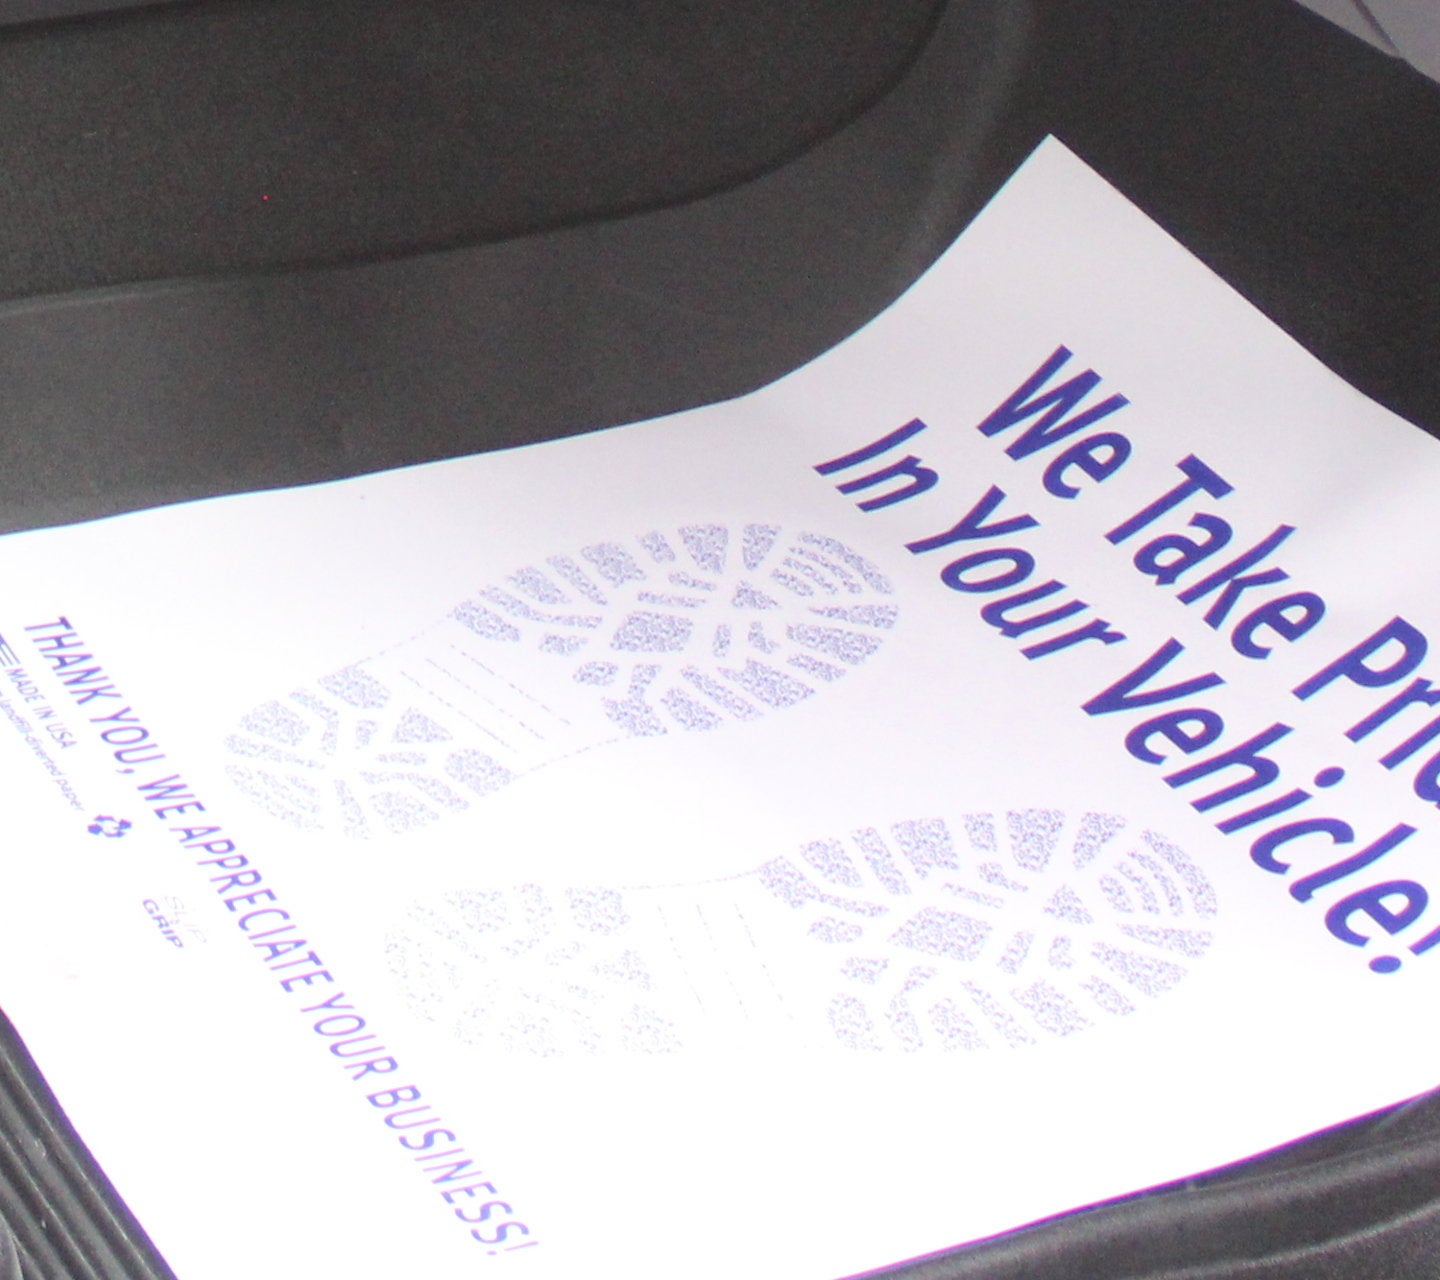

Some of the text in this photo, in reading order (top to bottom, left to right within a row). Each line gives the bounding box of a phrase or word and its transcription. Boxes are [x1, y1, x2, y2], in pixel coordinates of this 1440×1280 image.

[814, 418, 940, 512] In
[905, 485, 1127, 660] Your
[977, 345, 1133, 499] We
[1104, 454, 1326, 660] Take
[5, 668, 78, 749] MADE IN USA
[52, 778, 86, 812] paper
[24, 616, 539, 1256] THANK YOU, WE APPRECIATE YOUR BUSINESS!
[142, 898, 184, 949] GRIP
